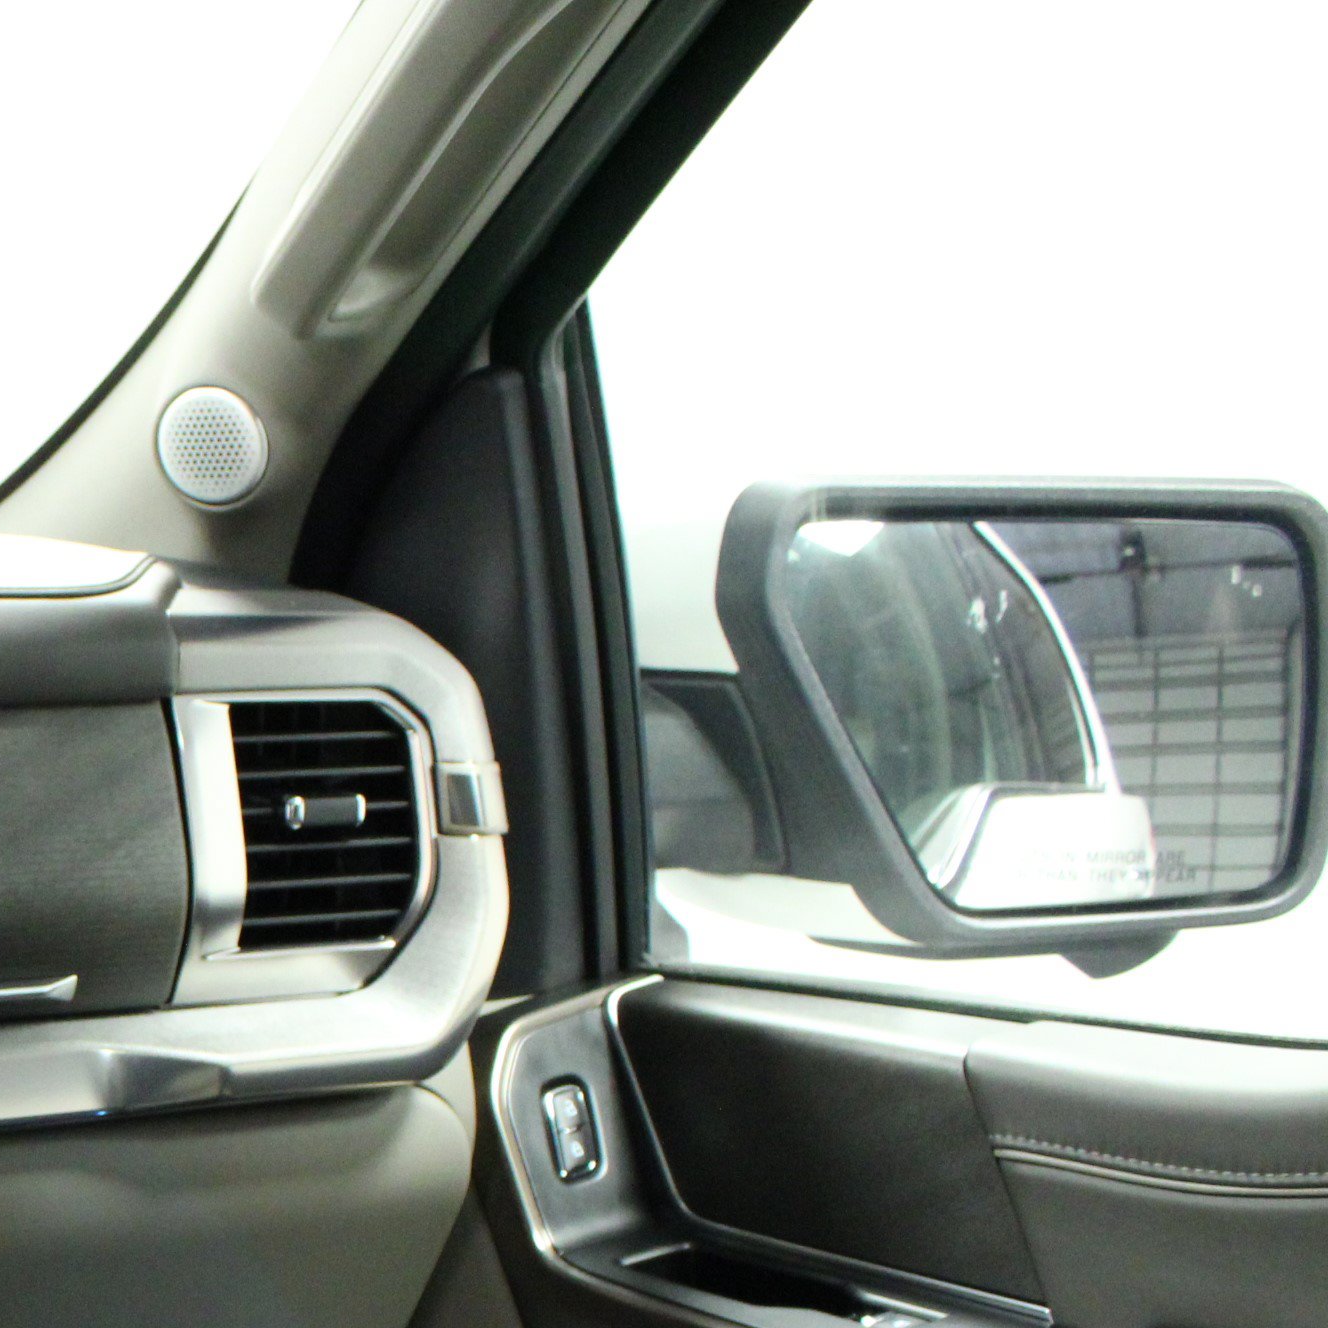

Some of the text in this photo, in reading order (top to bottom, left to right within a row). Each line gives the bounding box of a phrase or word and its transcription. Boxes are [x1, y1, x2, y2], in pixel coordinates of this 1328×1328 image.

[1086, 850, 1146, 865] MIRROR
[1156, 850, 1186, 863] ARE
[1089, 868, 1128, 882] THEY
